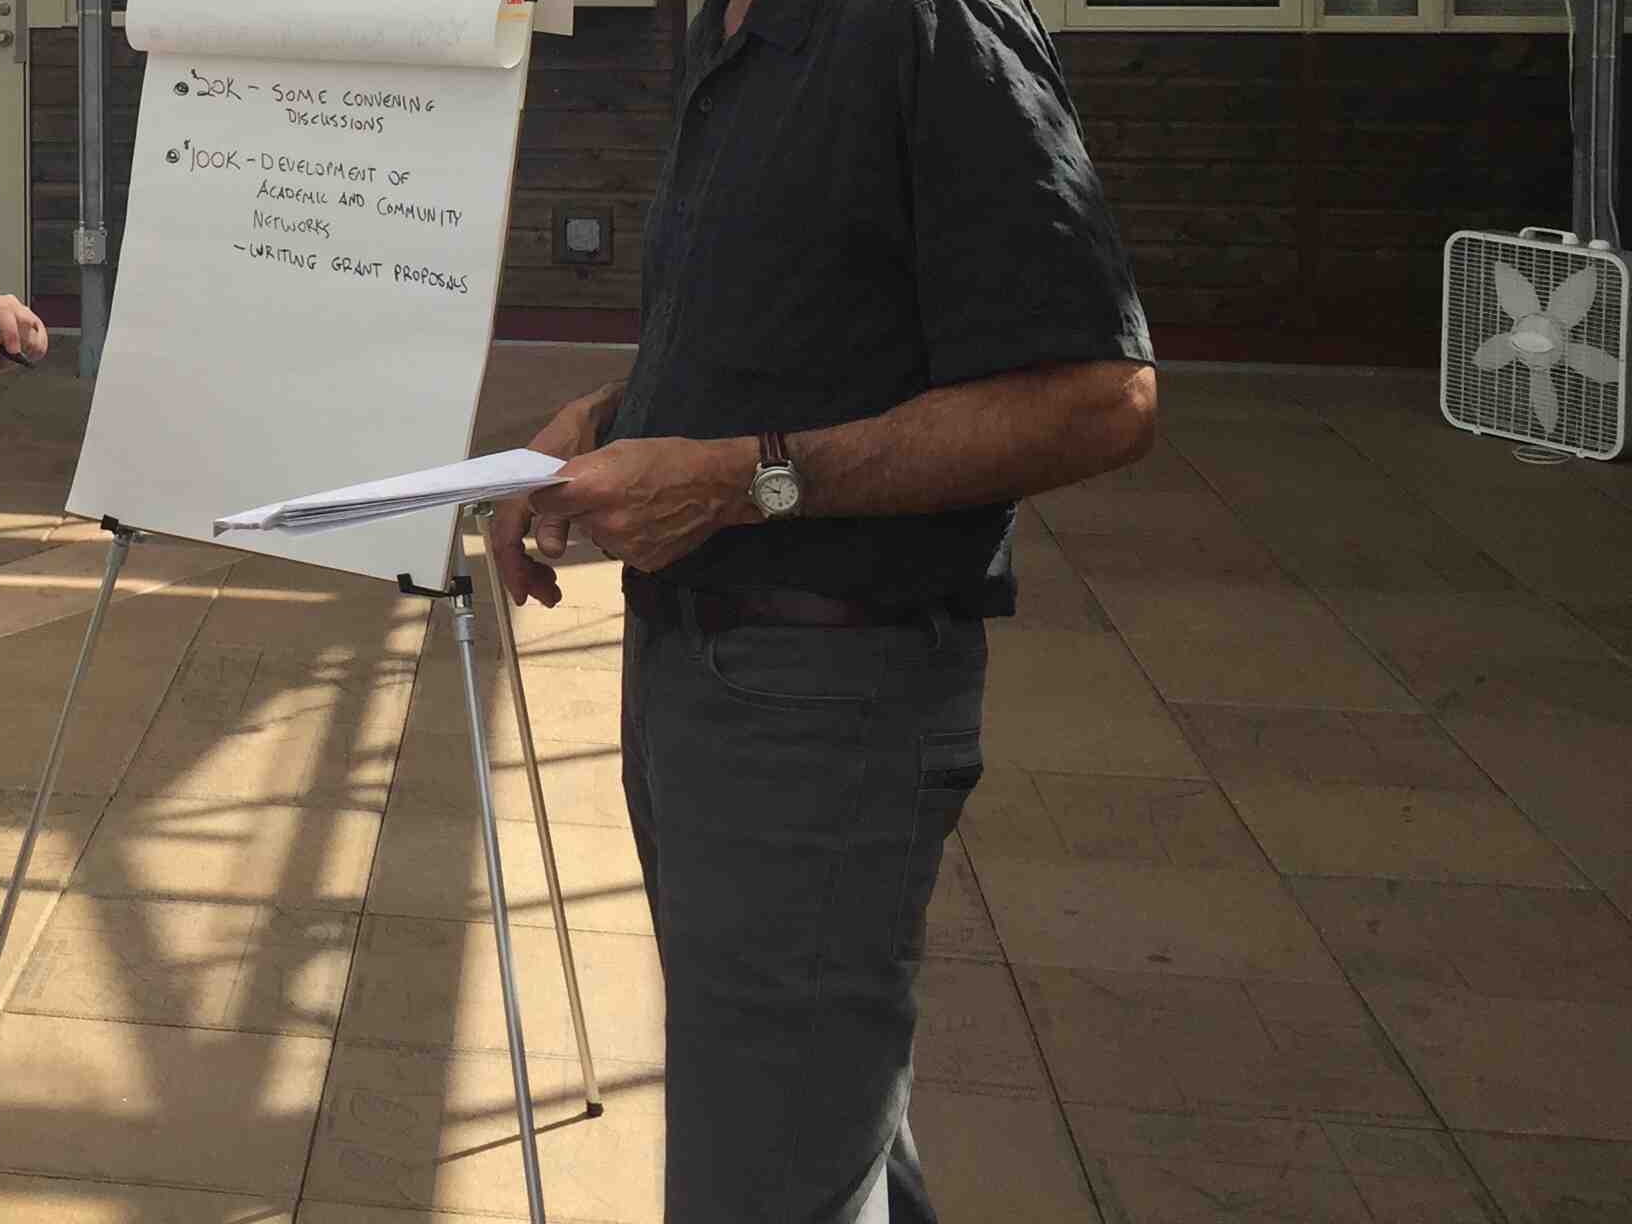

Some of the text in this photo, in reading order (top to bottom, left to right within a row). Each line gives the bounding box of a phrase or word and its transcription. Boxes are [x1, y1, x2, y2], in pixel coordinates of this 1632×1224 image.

[271, 83, 328, 105] SOME
[342, 87, 436, 113] CONVENING
[285, 107, 385, 134] DISCUSSIONS
[260, 152, 377, 183] DEVELOPMENT
[388, 170, 411, 186] OF
[256, 178, 463, 228] ACADEMIC AND COMMUNITY
[252, 209, 331, 239] NETWORKS
[331, 256, 383, 278] GRANT
